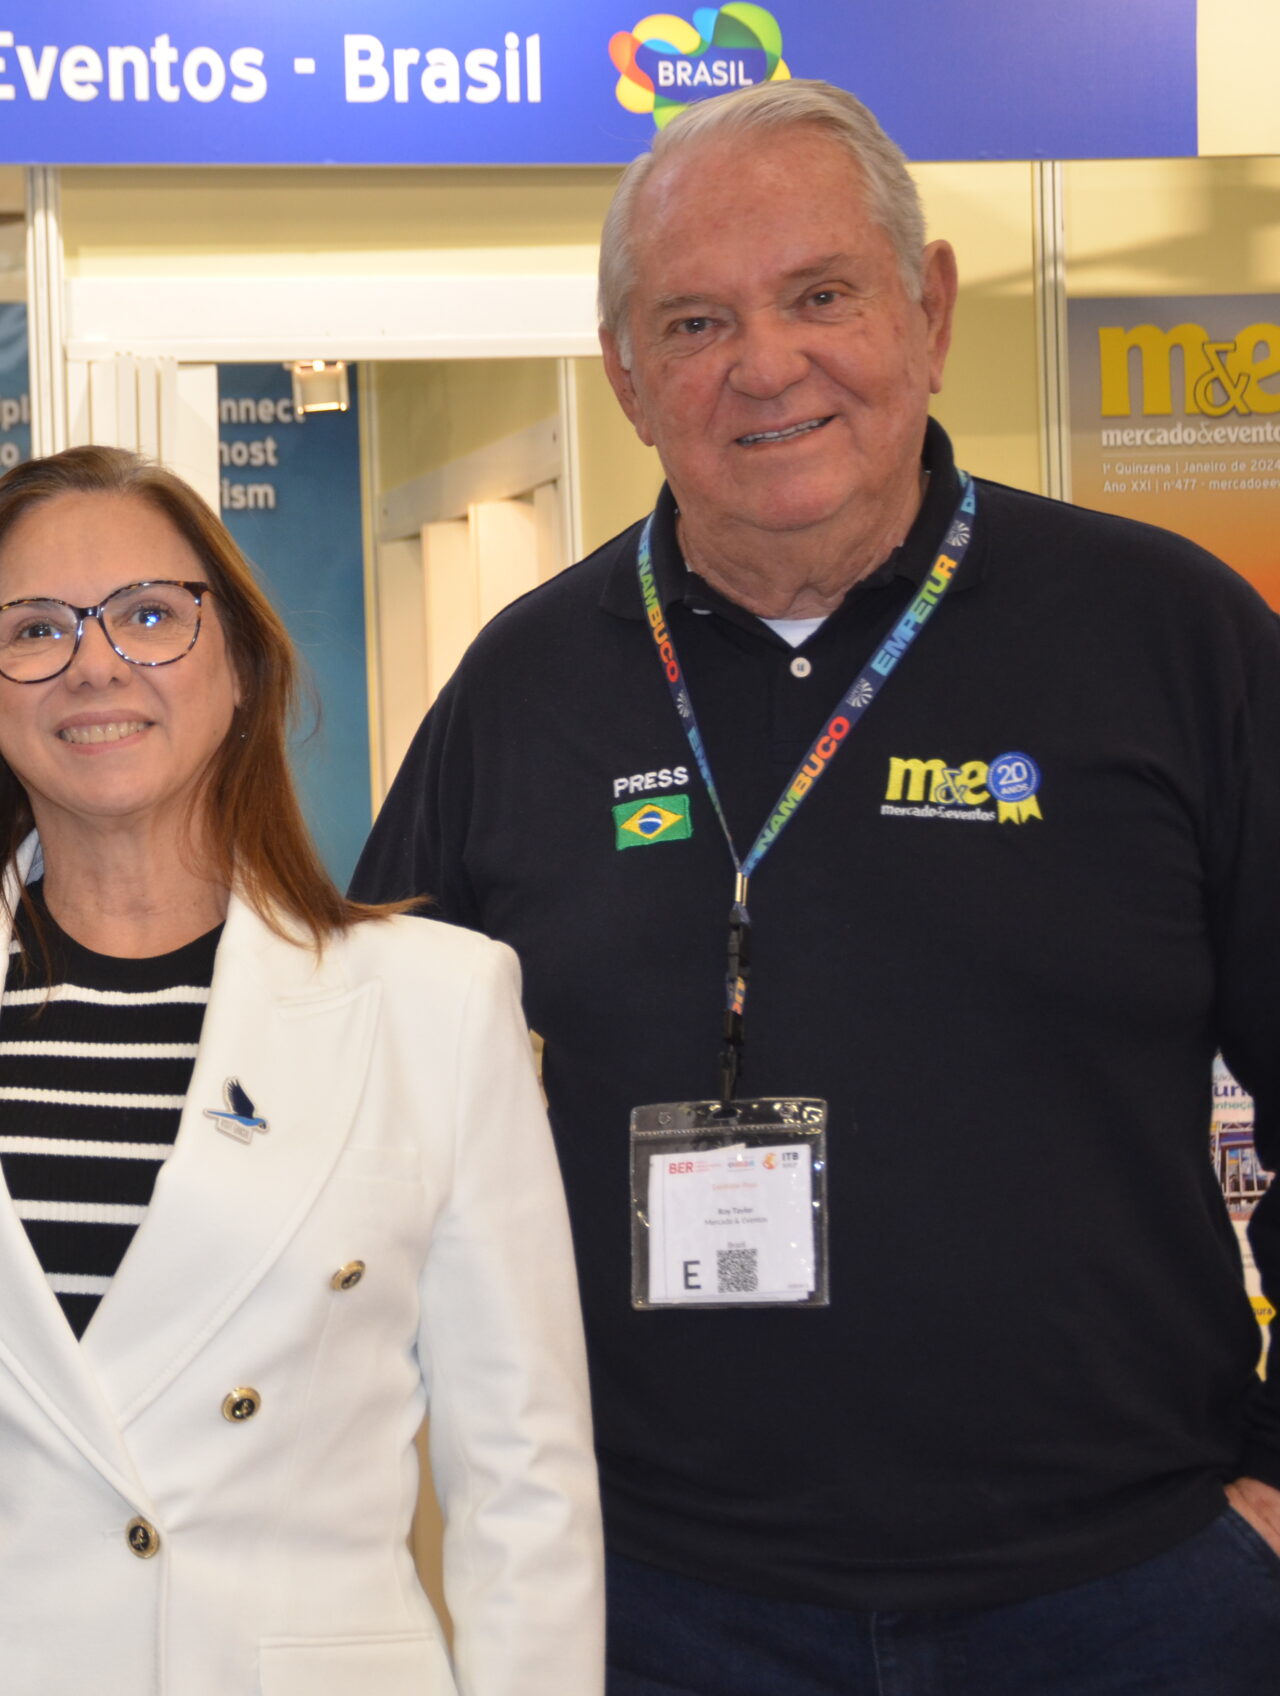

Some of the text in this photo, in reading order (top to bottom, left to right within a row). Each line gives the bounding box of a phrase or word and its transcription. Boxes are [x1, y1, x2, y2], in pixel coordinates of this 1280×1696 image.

[294, 57, 316, 74] -
[344, 31, 542, 104] Brasil
[658, 60, 754, 87] BRASIL
[1098, 322, 1280, 419] m&e
[1115, 462, 1171, 475] Quinzena
[1183, 460, 1227, 474] Janeiro
[1232, 460, 1246, 472] de
[1103, 480, 1127, 493] Ano
[1131, 479, 1151, 492] XXI
[871, 553, 958, 677] EMPETUR
[613, 766, 690, 797] PRESS
[885, 756, 991, 806] m&e
[997, 762, 1028, 785] 20
[880, 804, 996, 821] mercado&eventos
[668, 1161, 694, 1175] BER
[683, 1260, 701, 1290] E
